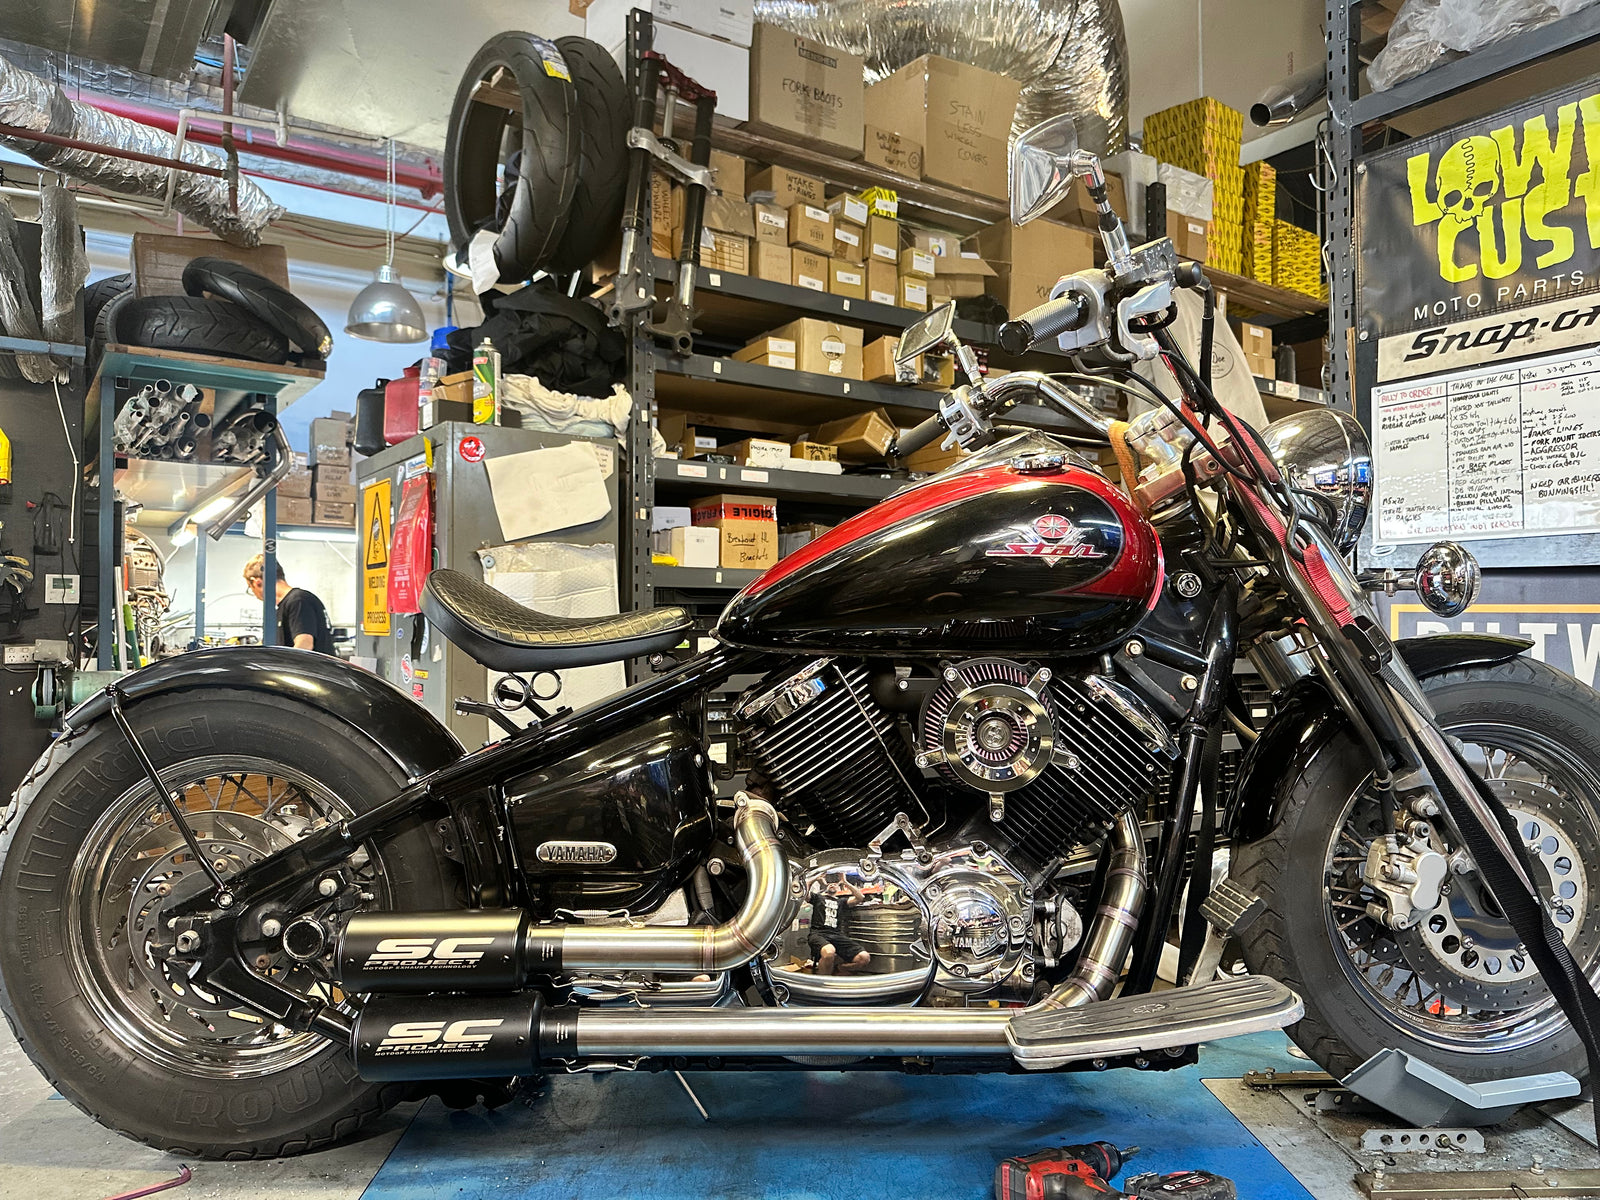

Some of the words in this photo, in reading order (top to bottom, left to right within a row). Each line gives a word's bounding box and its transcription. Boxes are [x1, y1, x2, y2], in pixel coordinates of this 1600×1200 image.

[782, 78, 811, 97] FORK
[814, 87, 843, 109] BOOTS
[949, 100, 986, 126] STAIN
[957, 119, 982, 138] LESS
[957, 148, 988, 167] COVERS
[785, 173, 814, 190] INTAKE
[1414, 293, 1482, 321] MOTO
[1498, 270, 1585, 301] PARTS
[1409, 386, 1433, 399] ORDER
[1556, 423, 1584, 433] LINES
[1531, 442, 1579, 455] AGGRESSOR
[368, 576, 386, 589] WELDING
[374, 594, 379, 606] IN
[367, 611, 387, 624] PROGRESS
[17, 714, 217, 891] PIRELLI
[546, 846, 606, 861] YAMAHA
[370, 937, 495, 960] SC
[952, 936, 991, 948] YAMAHA
[380, 1018, 504, 1045] SC
[376, 1042, 488, 1052] PROJECT
